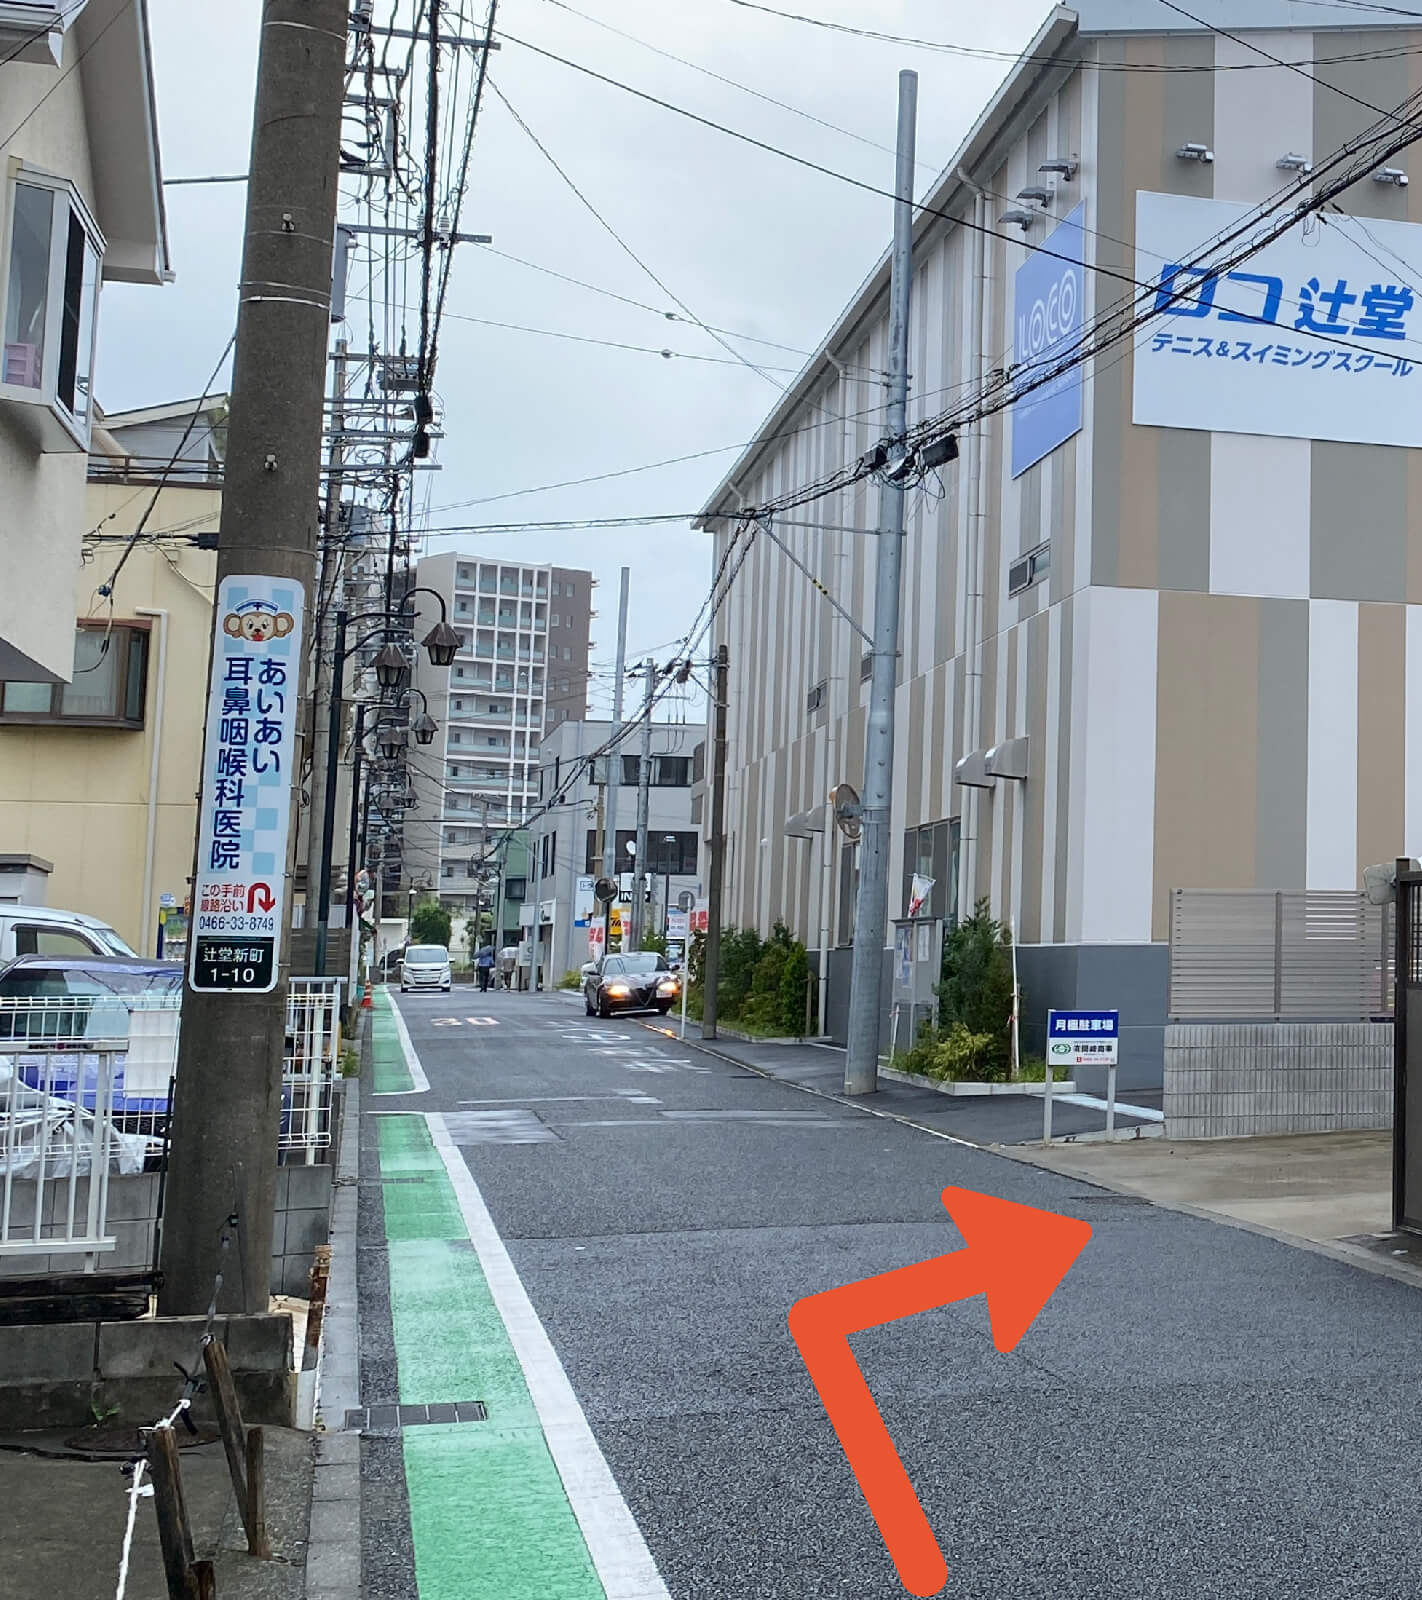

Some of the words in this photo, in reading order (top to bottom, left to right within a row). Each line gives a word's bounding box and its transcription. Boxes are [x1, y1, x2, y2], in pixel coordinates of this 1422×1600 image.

[253, 658, 287, 773] あいあい
[211, 657, 254, 869] 耳鼻咽喉科医院
[201, 884, 246, 898] この手前
[200, 916, 274, 930] 0466-33-8749
[203, 947, 264, 963] 辻堂新町
[210, 968, 255, 982] 1-10
